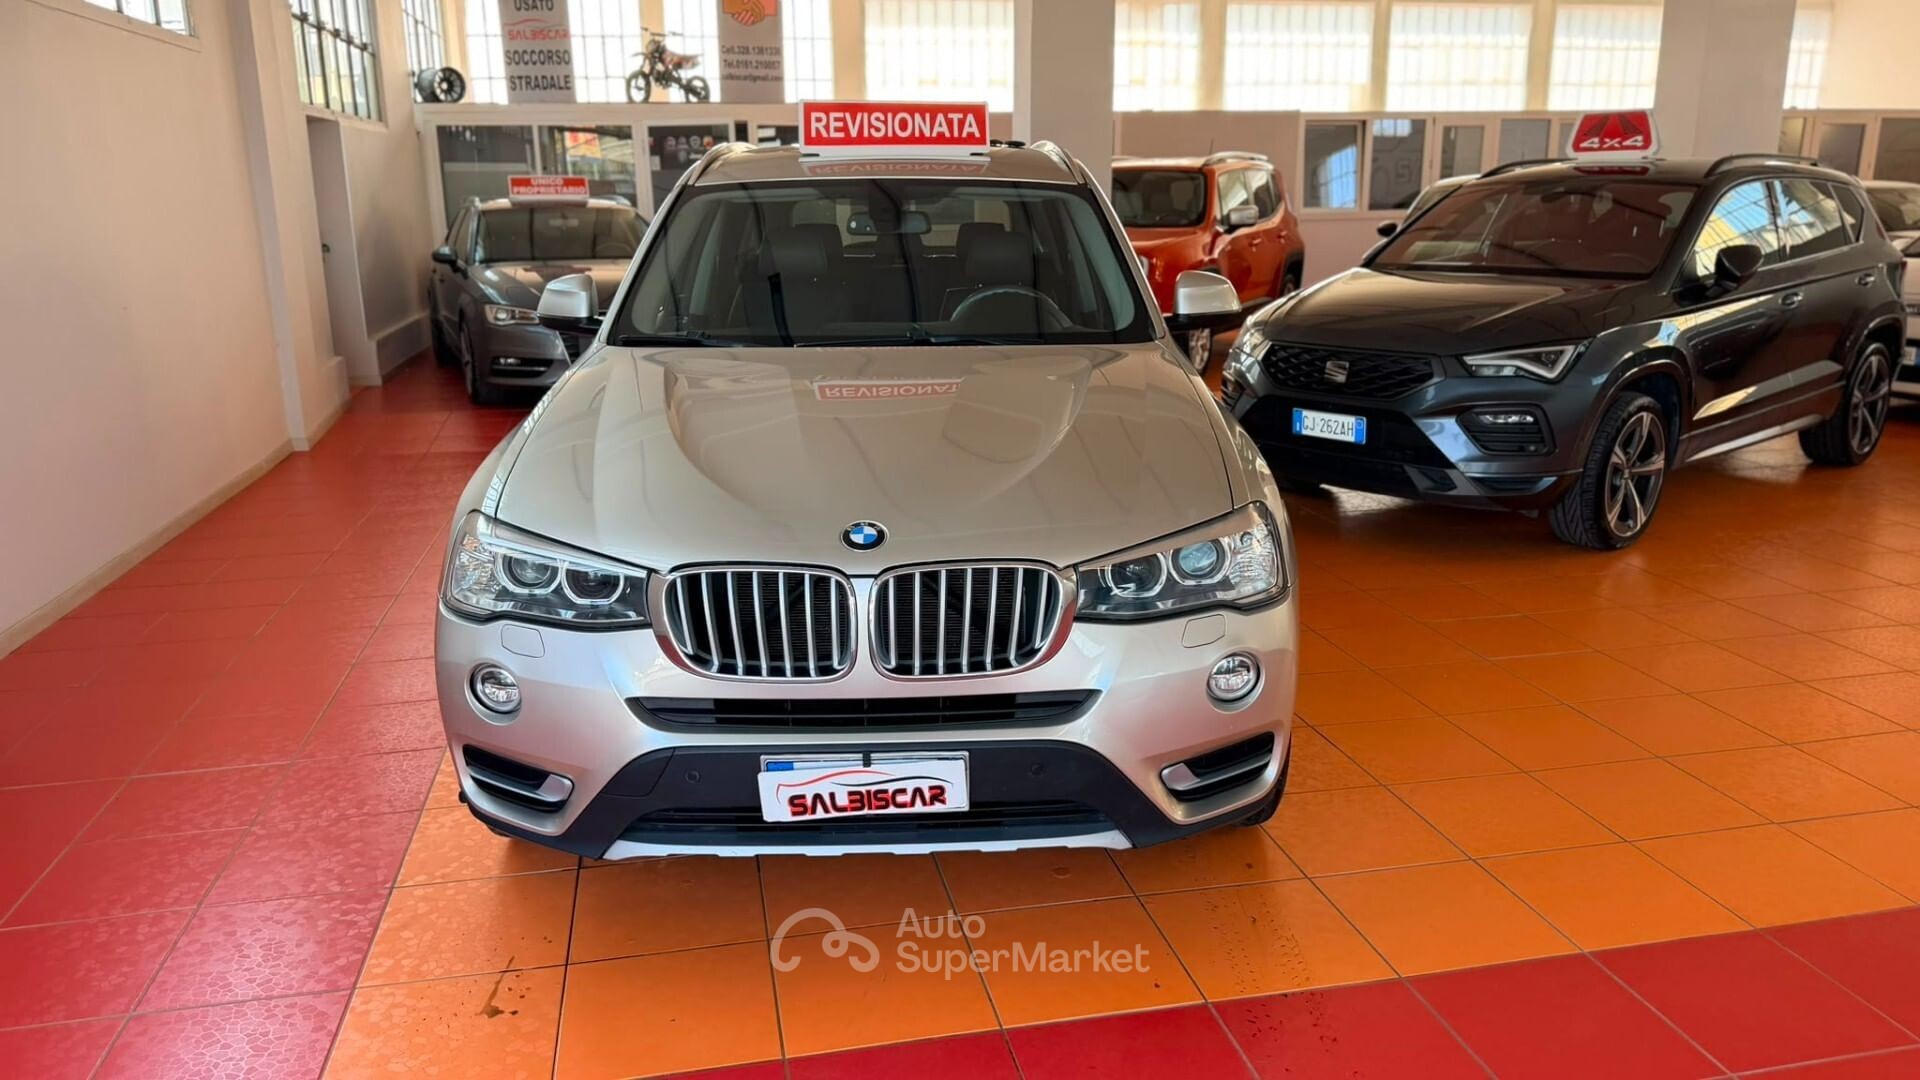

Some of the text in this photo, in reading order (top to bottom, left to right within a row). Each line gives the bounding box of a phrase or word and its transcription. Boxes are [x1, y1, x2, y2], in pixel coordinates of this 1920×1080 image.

[514, 0, 555, 12] USATO
[505, 49, 570, 66] SOCCORSO
[510, 75, 571, 91] STRADALE
[810, 112, 981, 138] REVISIONATA
[530, 178, 564, 186] UNICO
[513, 186, 587, 195] PROPRIETARIO
[1320, 418, 1354, 436] 262AH
[788, 785, 947, 817] SALBISCAR
